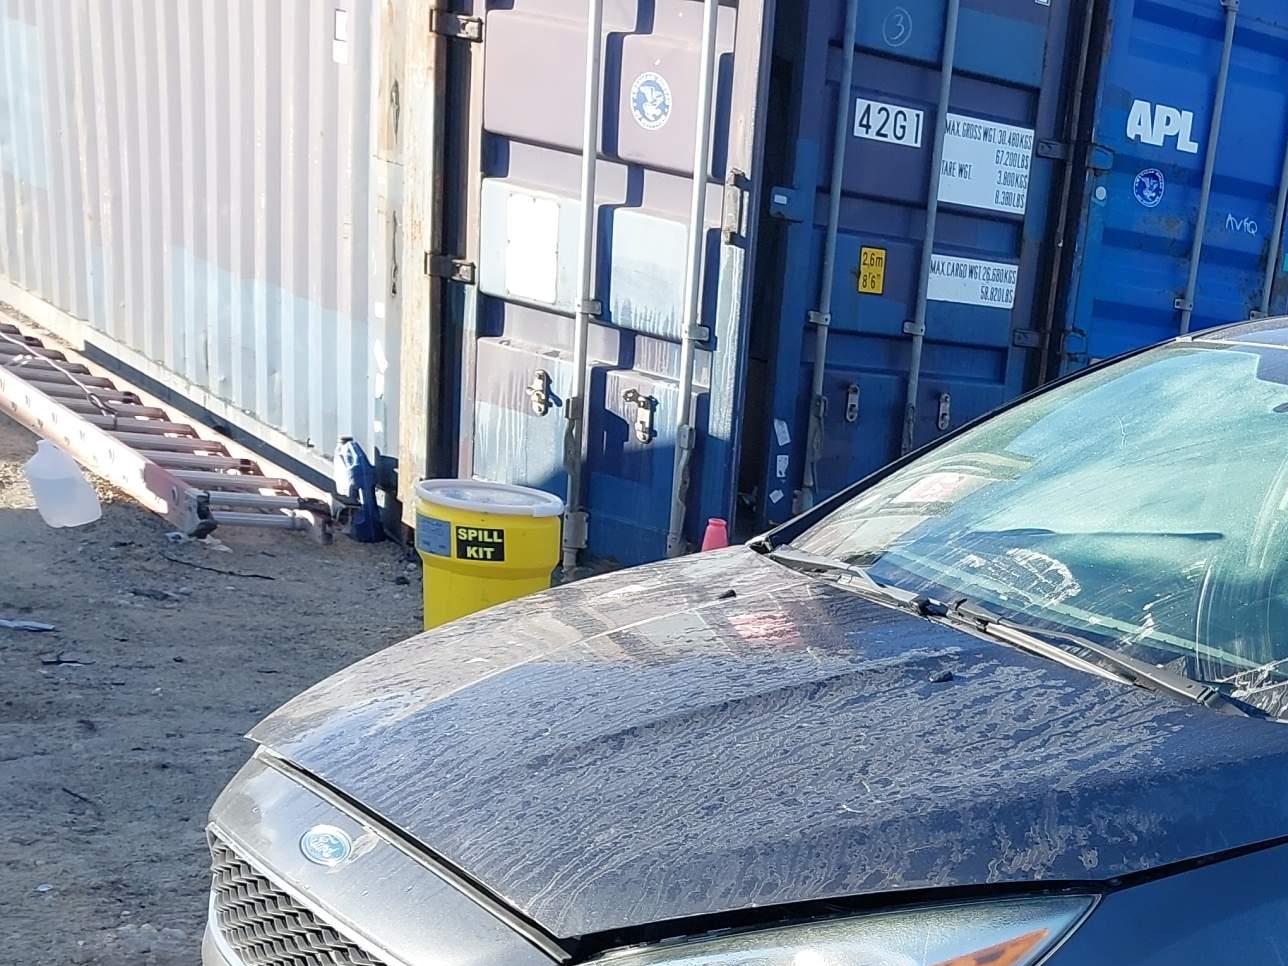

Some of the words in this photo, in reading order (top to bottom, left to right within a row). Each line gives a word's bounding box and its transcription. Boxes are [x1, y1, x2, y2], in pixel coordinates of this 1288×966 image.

[858, 103, 921, 145] 42G1
[962, 122, 982, 141] GROSS
[1126, 99, 1199, 154] APL
[941, 159, 956, 177] TARE
[946, 261, 968, 279] CARGO
[457, 528, 503, 543] SPILL
[466, 545, 495, 560] KIT
